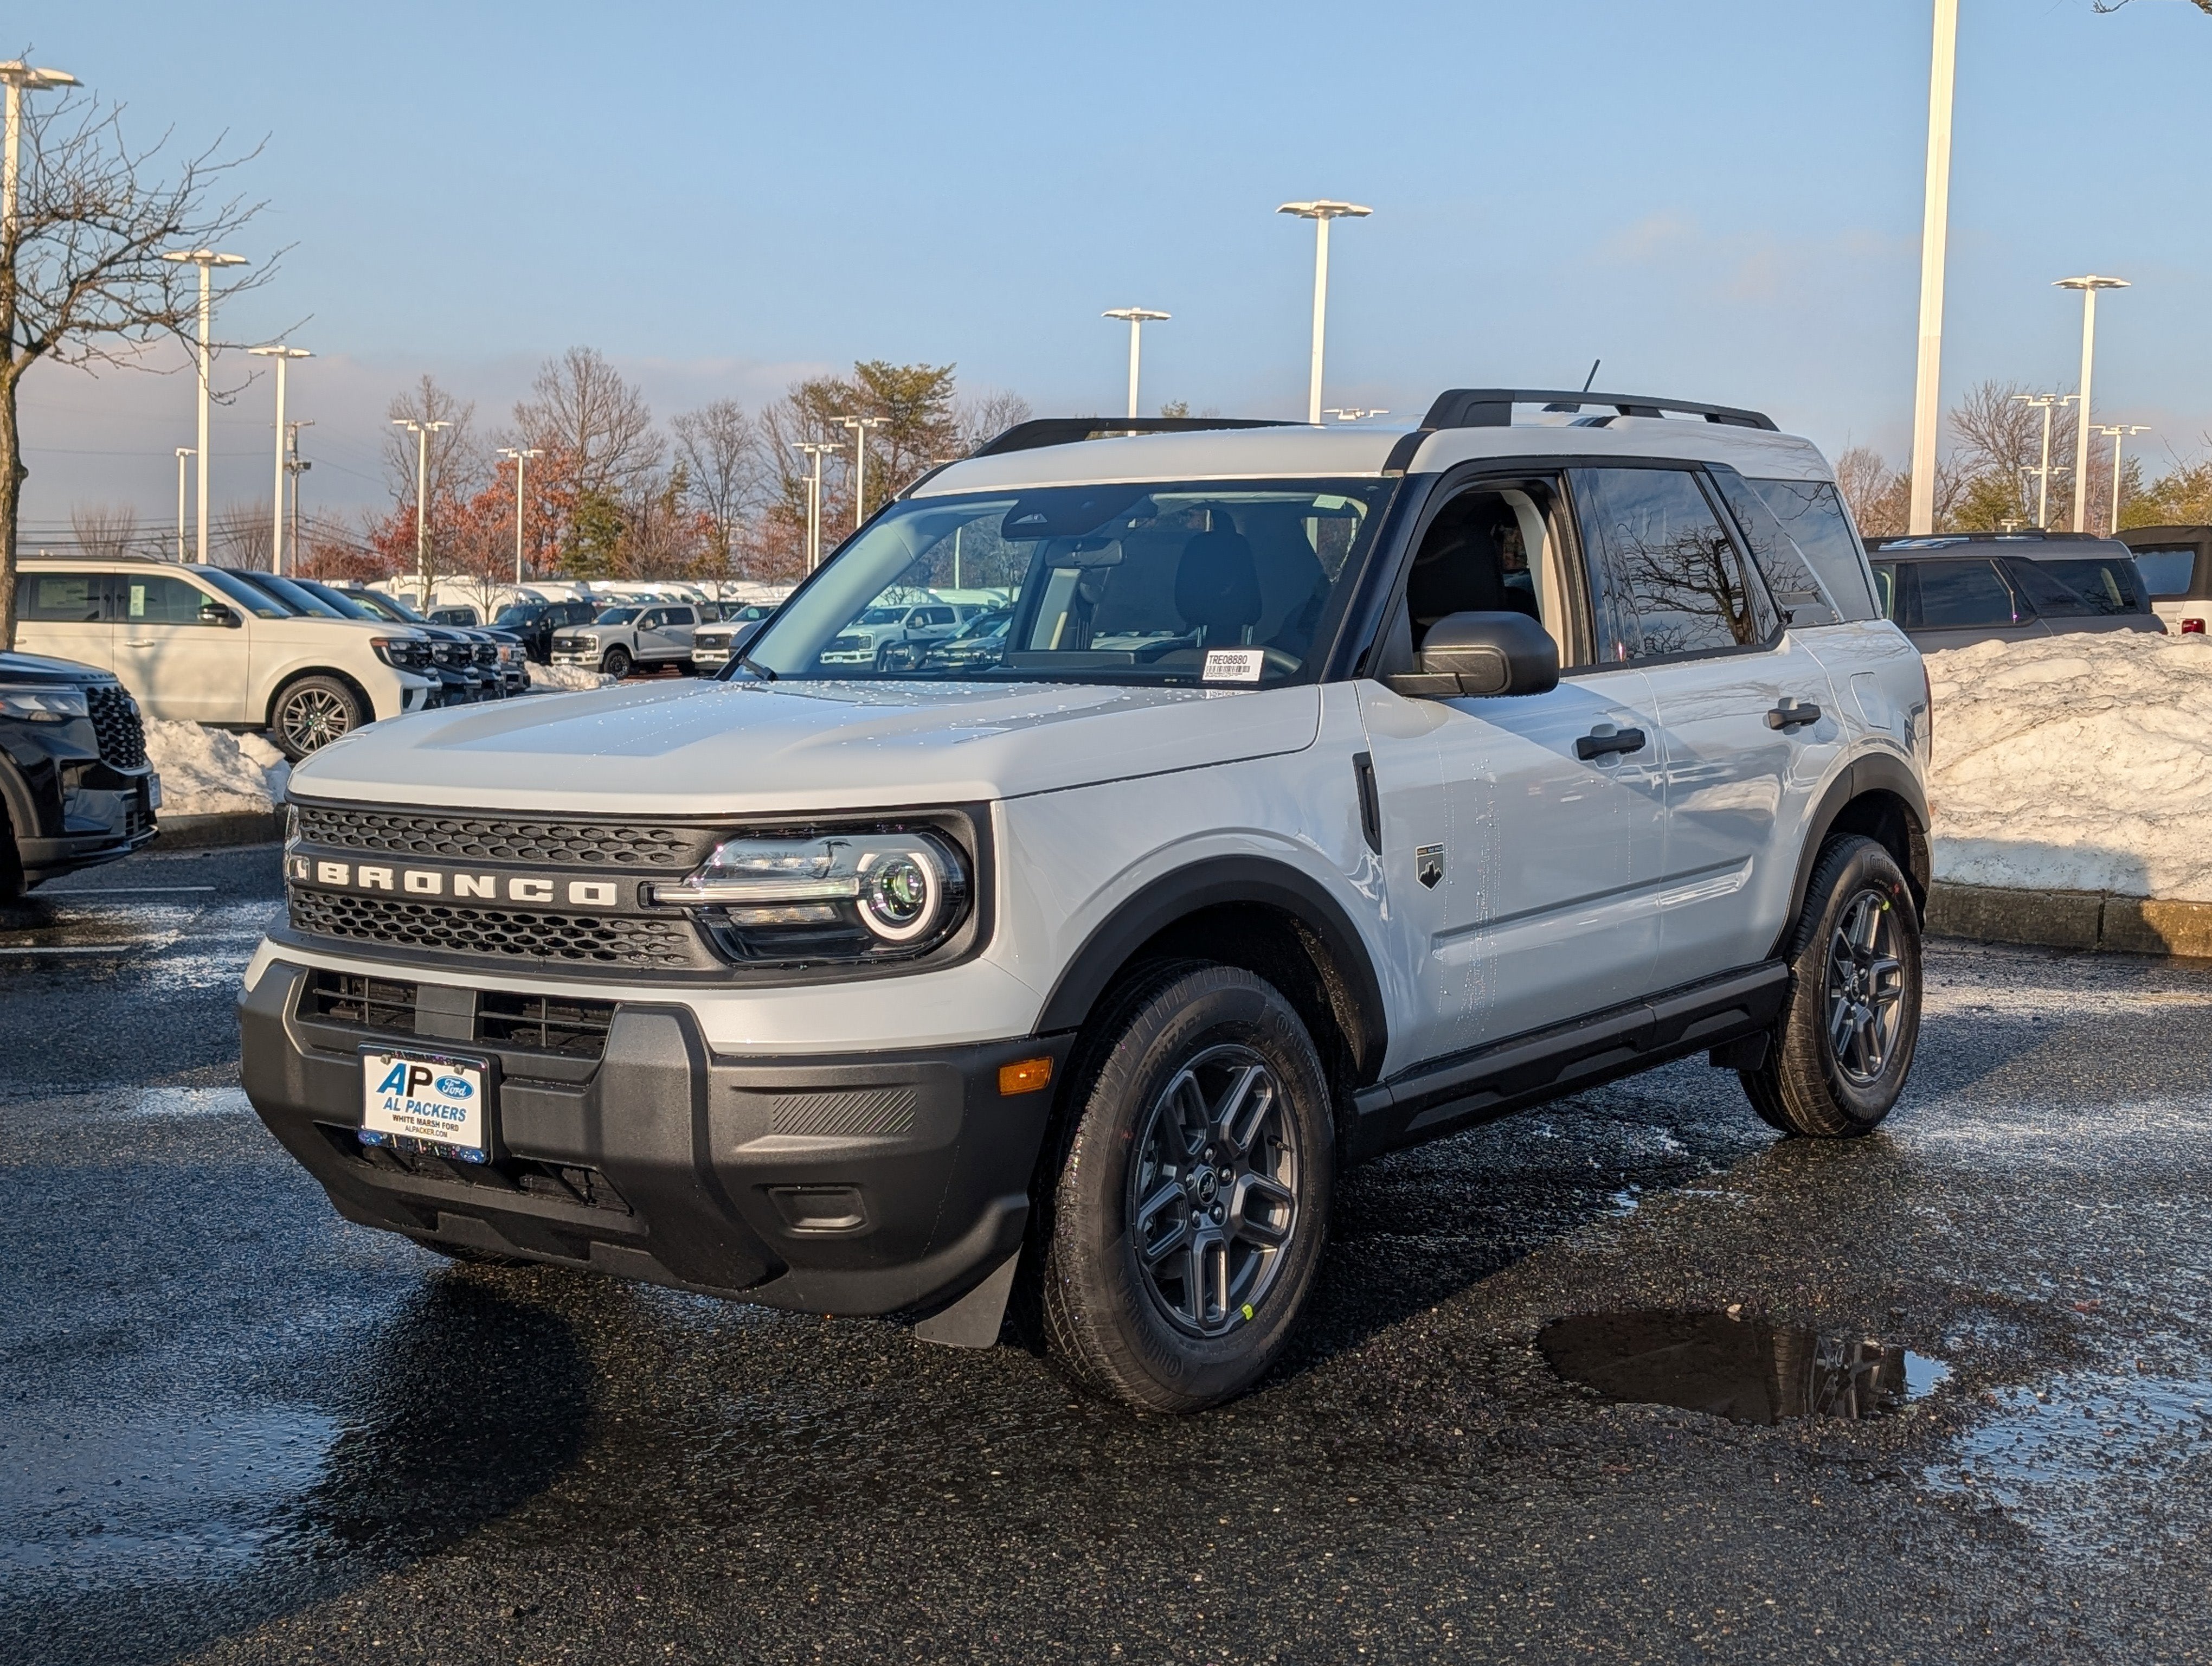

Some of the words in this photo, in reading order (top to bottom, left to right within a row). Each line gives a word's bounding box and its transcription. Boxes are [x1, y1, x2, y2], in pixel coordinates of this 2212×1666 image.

[1208, 655, 1248, 665] TRE08880
[317, 861, 618, 906] BRONCO
[376, 1062, 433, 1098] AP
[383, 1097, 401, 1111] AL
[405, 1099, 467, 1122] PACKERS
[392, 1114, 415, 1125] WHITE
[416, 1118, 440, 1128] MARSH
[442, 1122, 459, 1132] FORD
[404, 1125, 448, 1138] ALPACKER.COM
